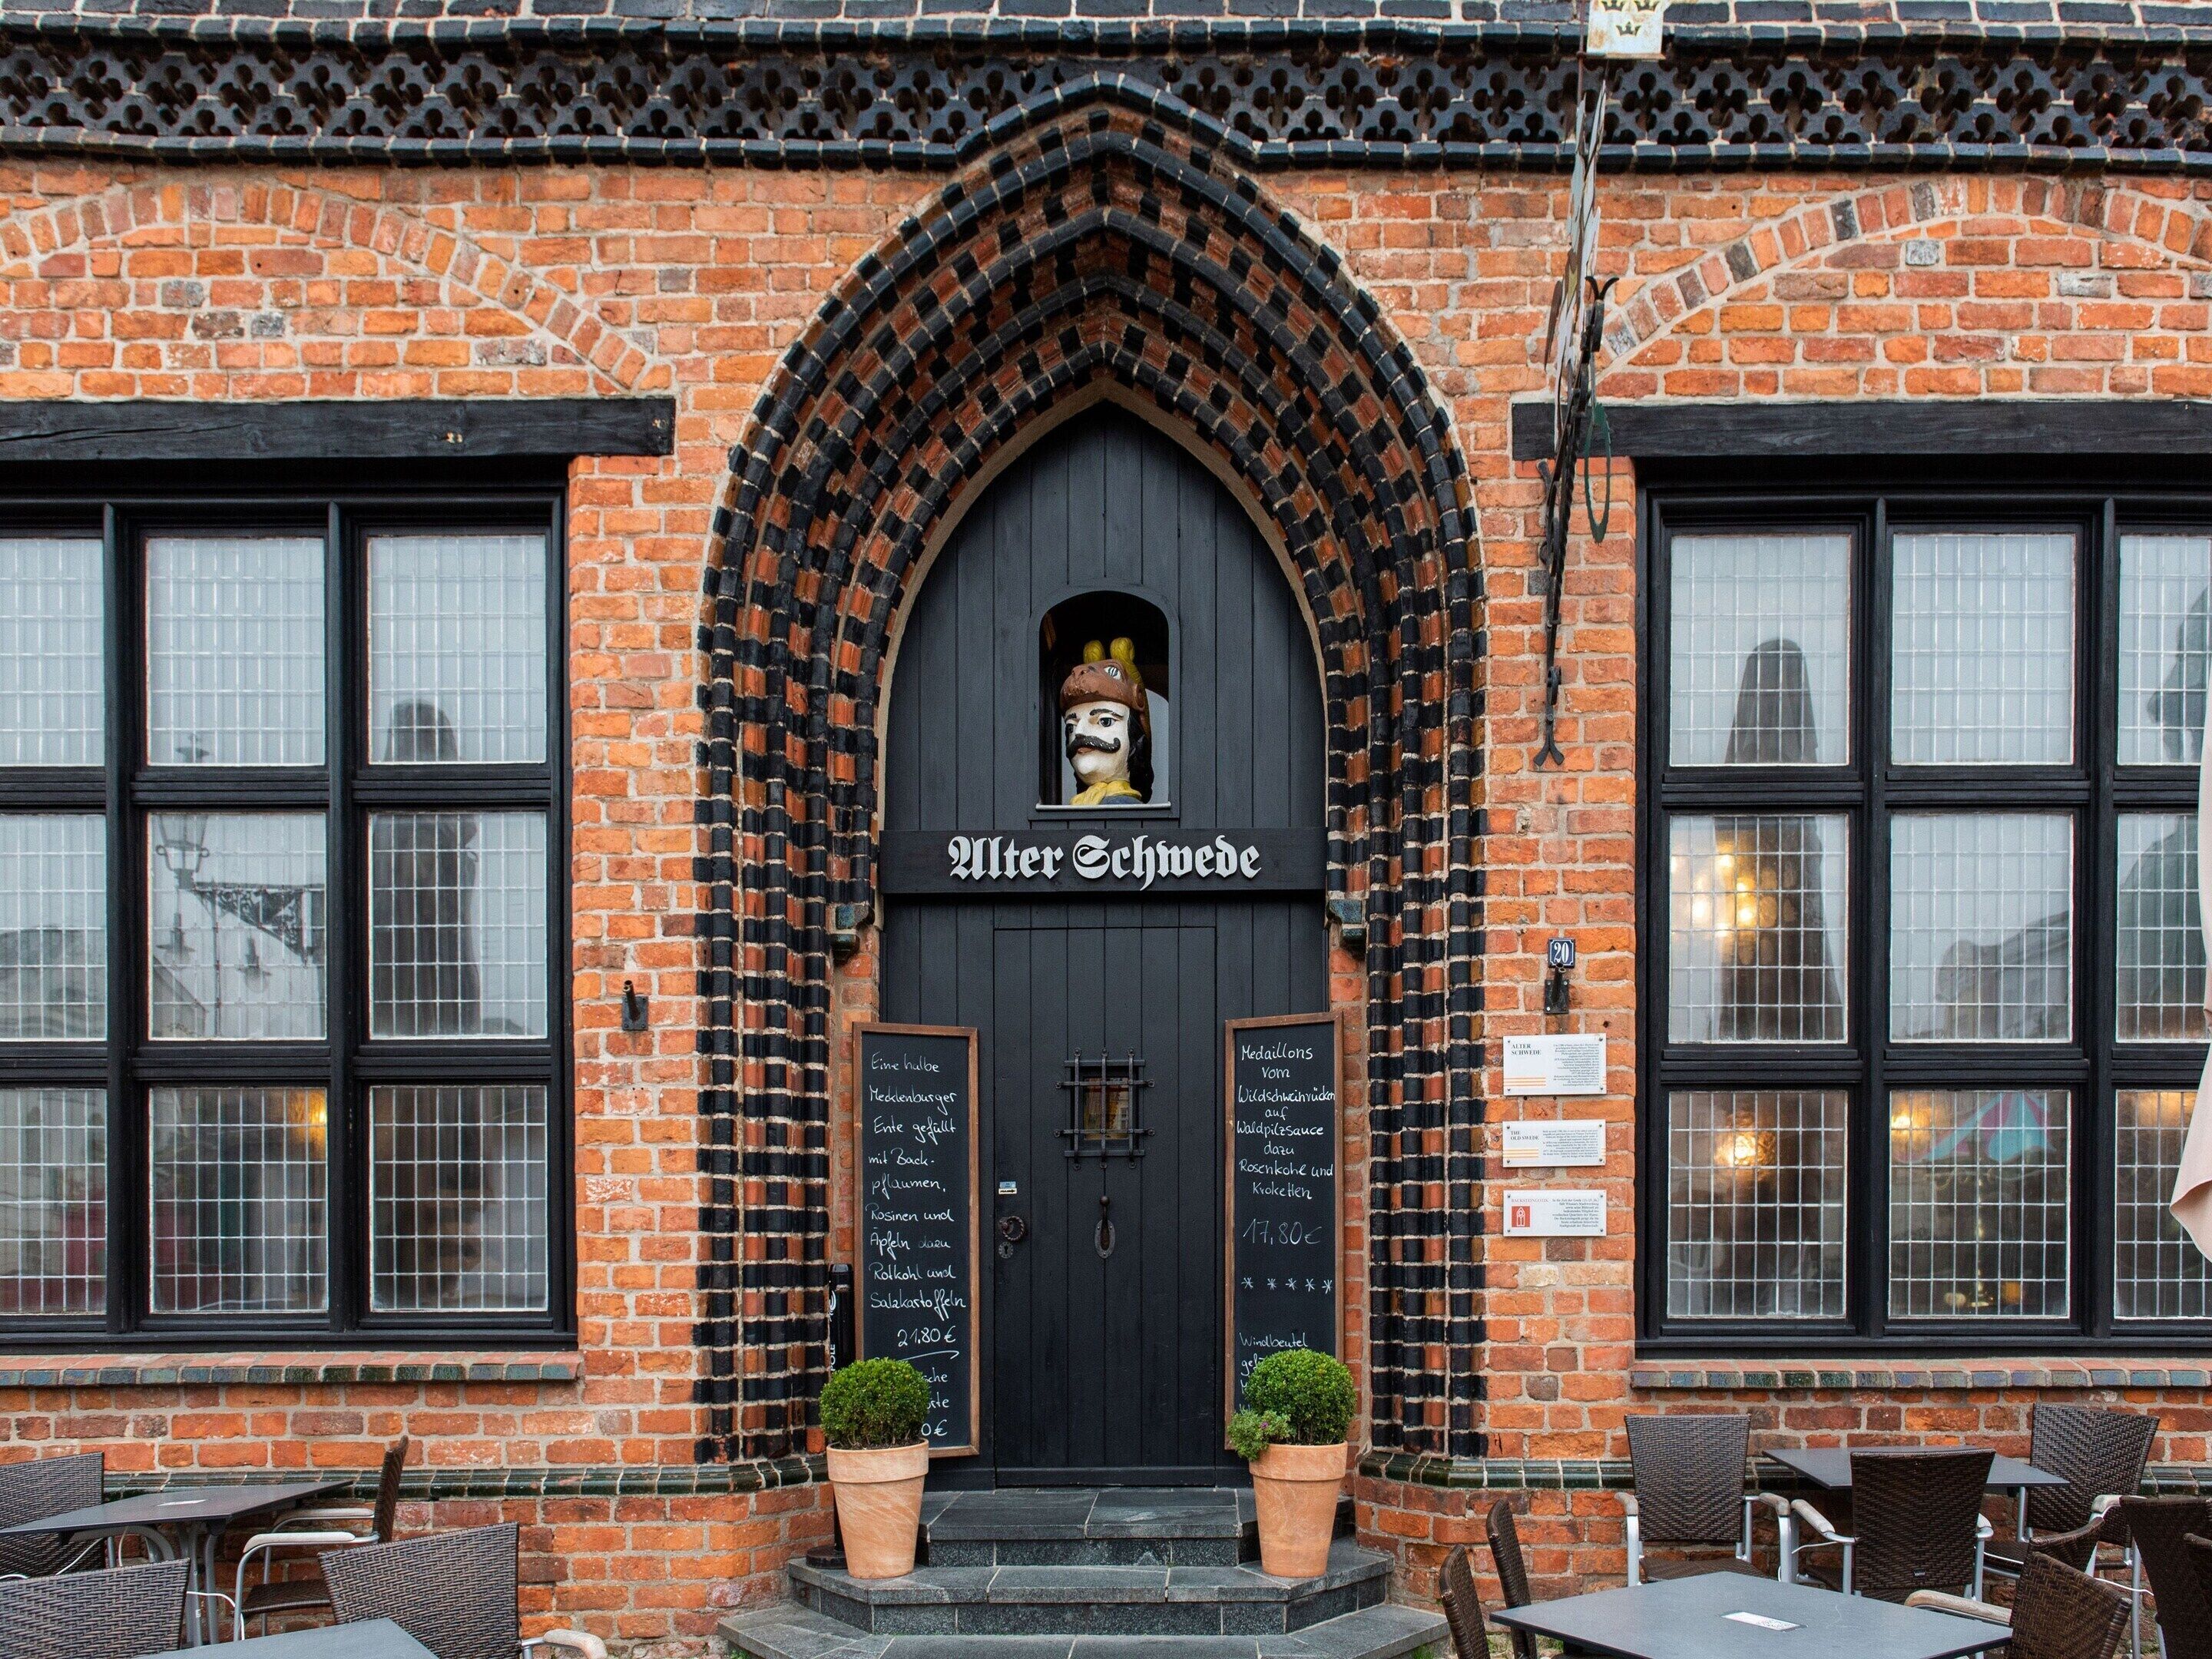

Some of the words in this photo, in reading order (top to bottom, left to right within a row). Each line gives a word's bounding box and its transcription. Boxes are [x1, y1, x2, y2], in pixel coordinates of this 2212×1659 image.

[948, 835, 1065, 880] Alter
[1073, 835, 1262, 891] Schwede
[1554, 942, 1570, 963] 20
[1241, 1041, 1313, 1061] Medaillons
[871, 1051, 899, 1071] Eine
[904, 1053, 940, 1073] halbe
[869, 1084, 957, 1115] Mecklenburger
[1265, 1106, 1288, 1121] auf
[873, 1116, 904, 1134] Ente
[912, 1116, 956, 1145] gefüllt
[1237, 1121, 1324, 1137] Waldpilzsauce
[868, 1151, 887, 1164] mit
[1264, 1141, 1294, 1155] dazu
[1253, 1181, 1313, 1200] Kroketten
[865, 1203, 919, 1221] Rosinen
[924, 1209, 955, 1222] und
[918, 1235, 951, 1248] dazu
[869, 1261, 923, 1280] Rotkohl
[927, 1264, 956, 1279] und
[870, 1288, 966, 1321] Salzkartoffeln
[1239, 1332, 1308, 1347] Windbeutel
